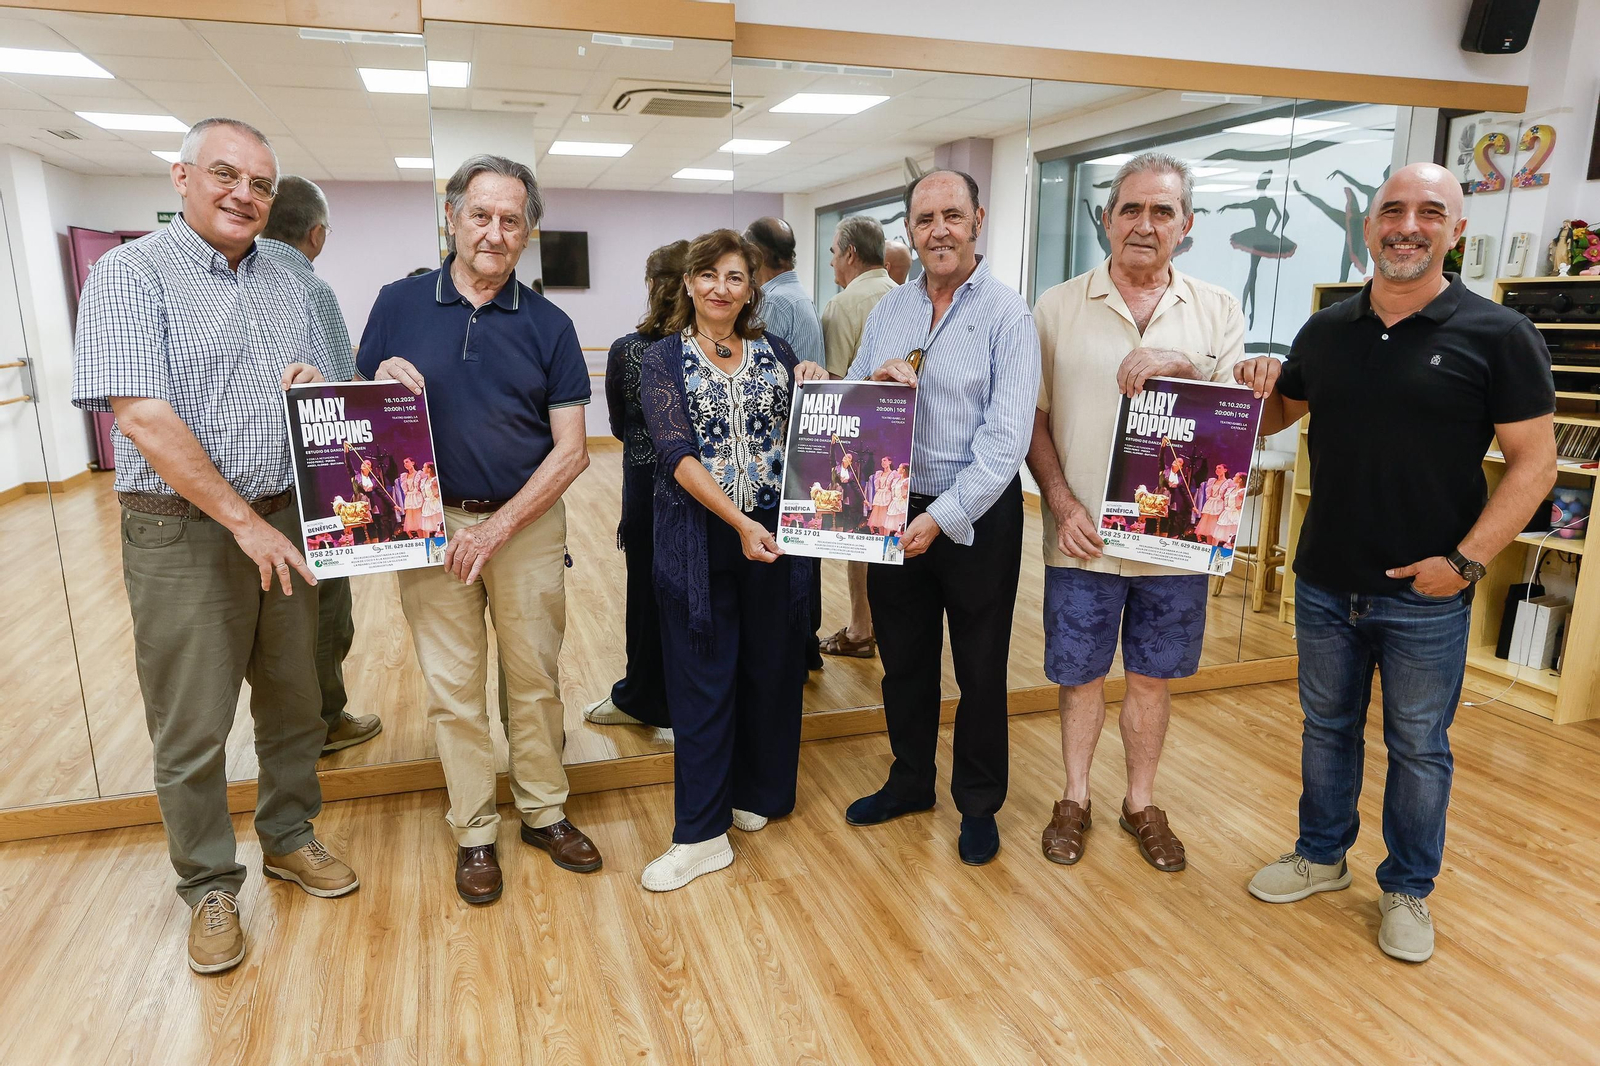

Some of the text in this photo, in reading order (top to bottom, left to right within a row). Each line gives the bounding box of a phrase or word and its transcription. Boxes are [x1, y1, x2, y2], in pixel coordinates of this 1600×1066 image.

[297, 397, 346, 424] MARY
[801, 393, 843, 415] MARY
[1129, 390, 1178, 416] MARY
[300, 420, 374, 448] POPPINS
[798, 414, 860, 438] POPPINS
[1125, 412, 1196, 443] POPPINS
[307, 523, 338, 533] BENÉFICA
[325, 549, 334, 557] 25
